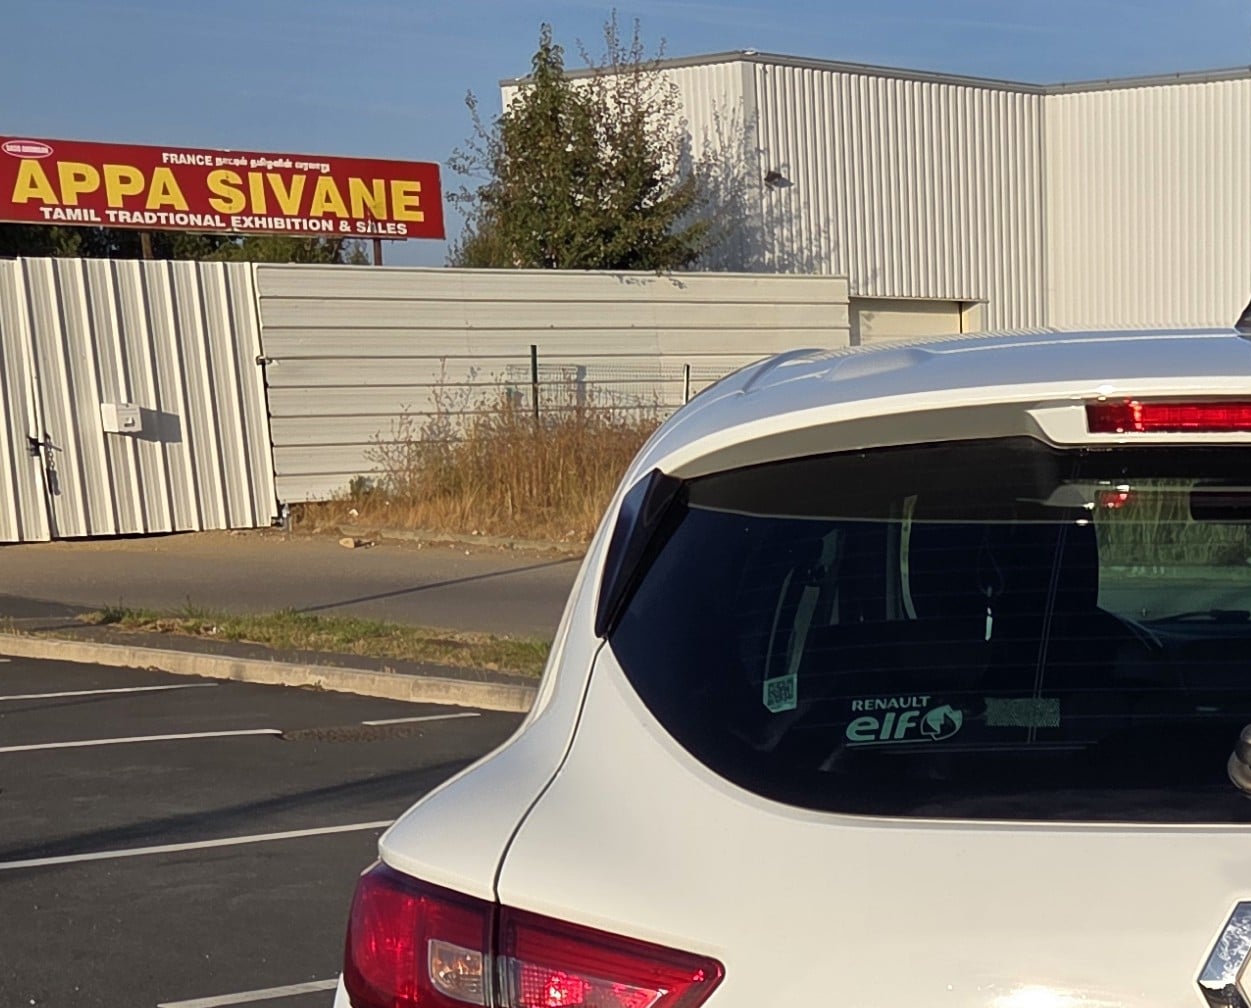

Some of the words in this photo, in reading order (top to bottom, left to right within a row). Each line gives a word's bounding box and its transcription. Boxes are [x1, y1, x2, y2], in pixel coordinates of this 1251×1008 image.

[162, 152, 213, 167] FRANCE
[11, 159, 190, 211] APPA
[206, 169, 425, 222] SIVANE
[39, 206, 102, 222] TAMIL
[105, 209, 227, 228] TRADTIONAL
[230, 215, 334, 232] EXHIBITION
[338, 220, 351, 232] &
[852, 696, 931, 712] RENAULT
[845, 710, 921, 742] elf
